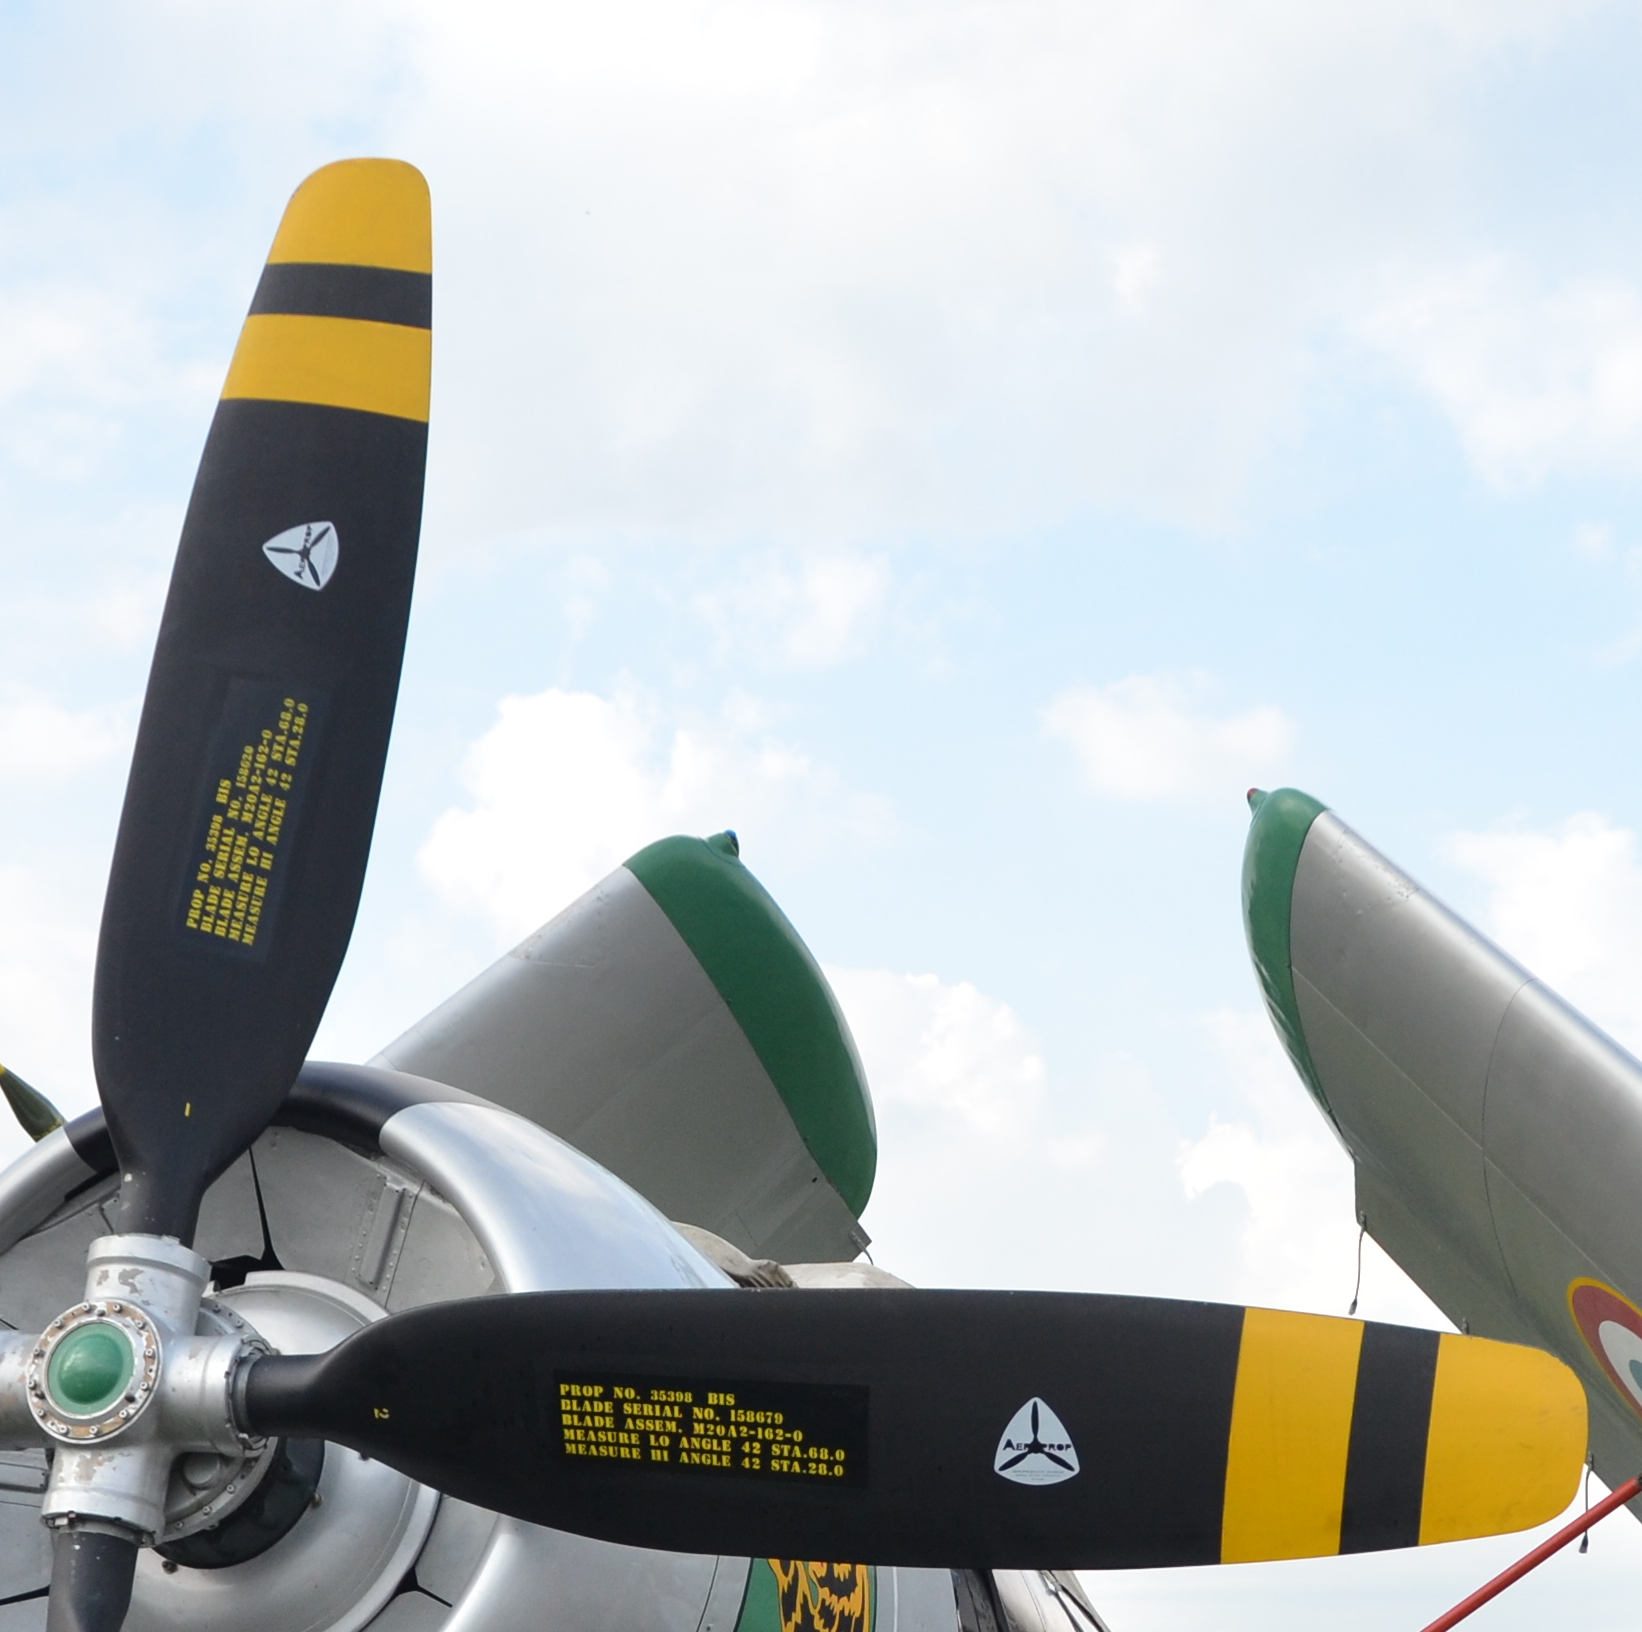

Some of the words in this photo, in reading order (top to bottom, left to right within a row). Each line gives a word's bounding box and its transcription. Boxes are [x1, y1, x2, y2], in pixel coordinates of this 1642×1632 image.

[271, 697, 294, 761] STA.68.0
[265, 767, 278, 785] 42
[243, 876, 267, 945] MEASURE
[266, 798, 285, 844] ANGLE
[279, 772, 291, 790] 42
[285, 702, 308, 765] STA.28.0
[252, 793, 272, 839] ANGLE
[186, 888, 204, 928] PROP
[197, 857, 212, 882] NO.
[205, 813, 222, 851] 35398
[216, 778, 231, 803] BIS
[200, 884, 220, 932] BLADE
[213, 826, 234, 878] SERIAL
[228, 794, 242, 819] NO.
[246, 846, 259, 864] LO
[214, 888, 234, 936] BLADE
[227, 829, 248, 882] ASSEM.
[228, 871, 253, 940] MEASURE
[559, 1384, 603, 1397] PROP
[613, 1387, 640, 1400] NO.
[650, 1389, 693, 1403] 35398
[707, 1392, 735, 1406] BIS
[560, 1399, 613, 1413] BLADE
[623, 1403, 682, 1418] SERIAL
[692, 1407, 720, 1420] NO.
[729, 1409, 783, 1425] 158679
[561, 1414, 614, 1429] BLADE
[624, 1418, 682, 1433] ASSEM.
[693, 1423, 803, 1442] M20A2-162-0
[562, 1428, 640, 1445] MEASURE
[649, 1435, 670, 1447] LO
[679, 1437, 731, 1452] ANGLE
[741, 1441, 761, 1454] 42
[771, 1443, 845, 1461] STA.68.0
[564, 1443, 640, 1459] MEASURE
[679, 1452, 731, 1467] ANGLE
[741, 1457, 761, 1470] 42
[771, 1459, 844, 1476] STA.28.0
